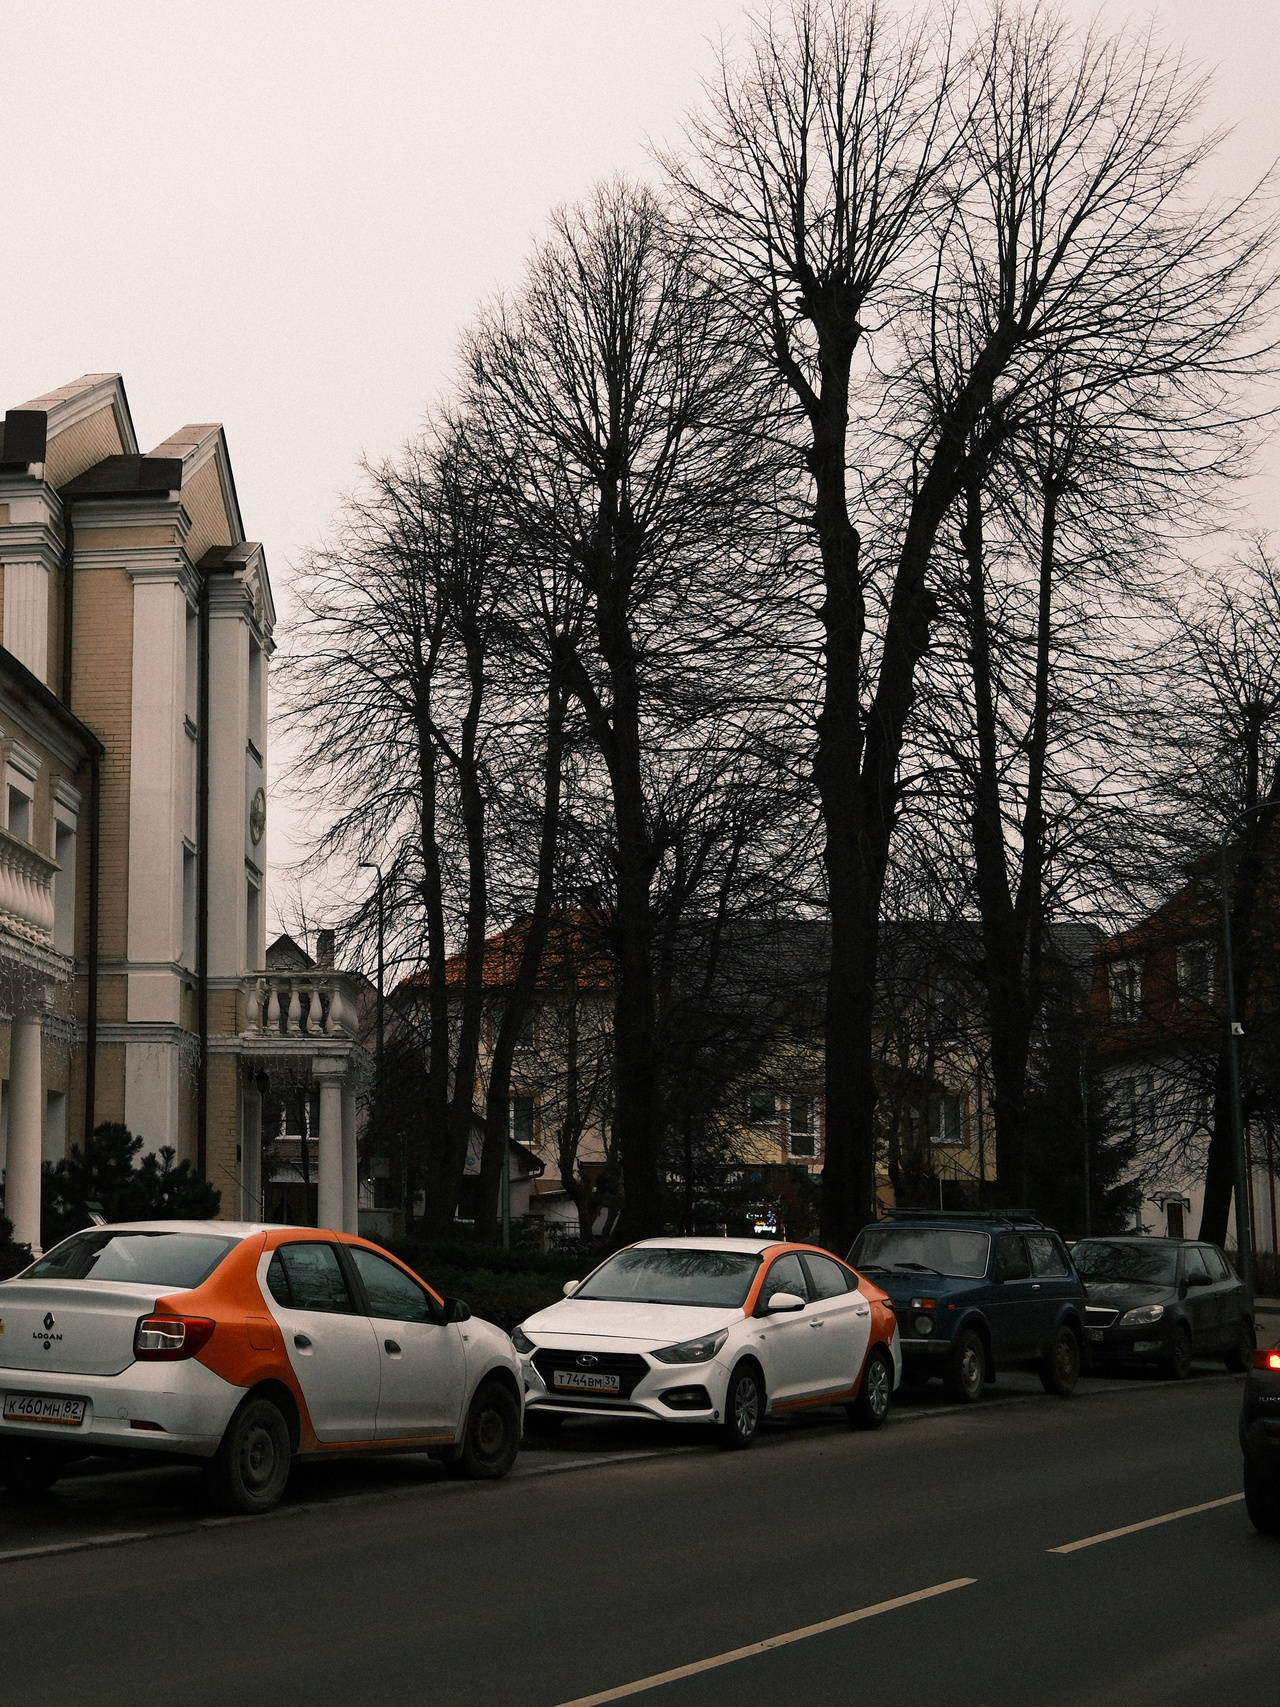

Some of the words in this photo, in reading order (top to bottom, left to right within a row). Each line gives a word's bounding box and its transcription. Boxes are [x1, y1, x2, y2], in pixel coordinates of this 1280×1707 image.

[32, 1332, 63, 1340] LOGAN
[604, 1376, 616, 1386] 39
[64, 1401, 80, 1414] 82
